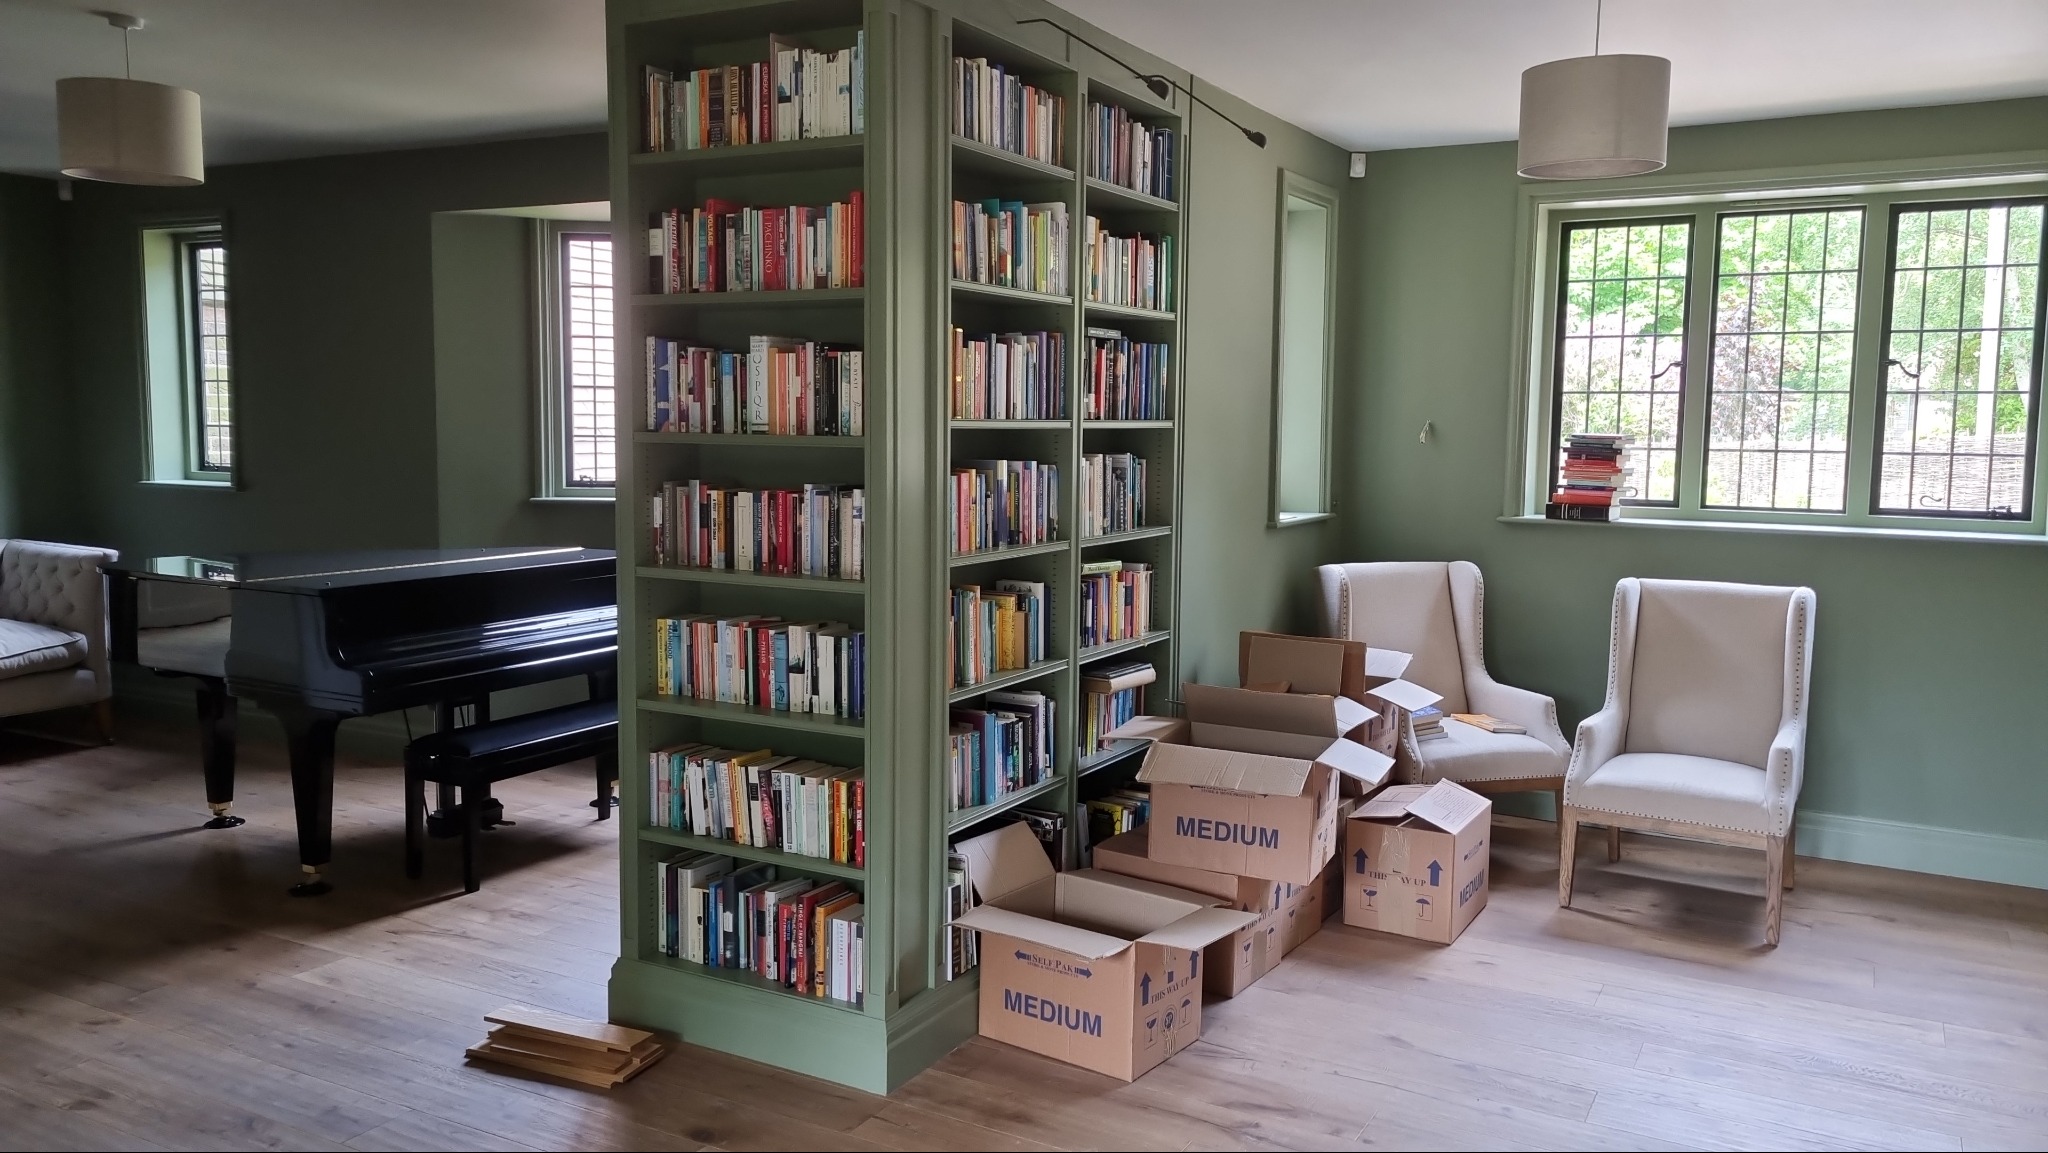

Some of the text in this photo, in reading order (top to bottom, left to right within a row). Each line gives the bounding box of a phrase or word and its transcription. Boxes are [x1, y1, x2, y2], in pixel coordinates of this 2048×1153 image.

[764, 222, 773, 273] PACHINKO
[1176, 816, 1279, 850] MEDIUM
[1414, 878, 1426, 886] UP
[1459, 868, 1484, 908] MEDIUM
[1151, 976, 1190, 1004] THIS WAY UP
[1004, 988, 1102, 1038] MEDIUM
